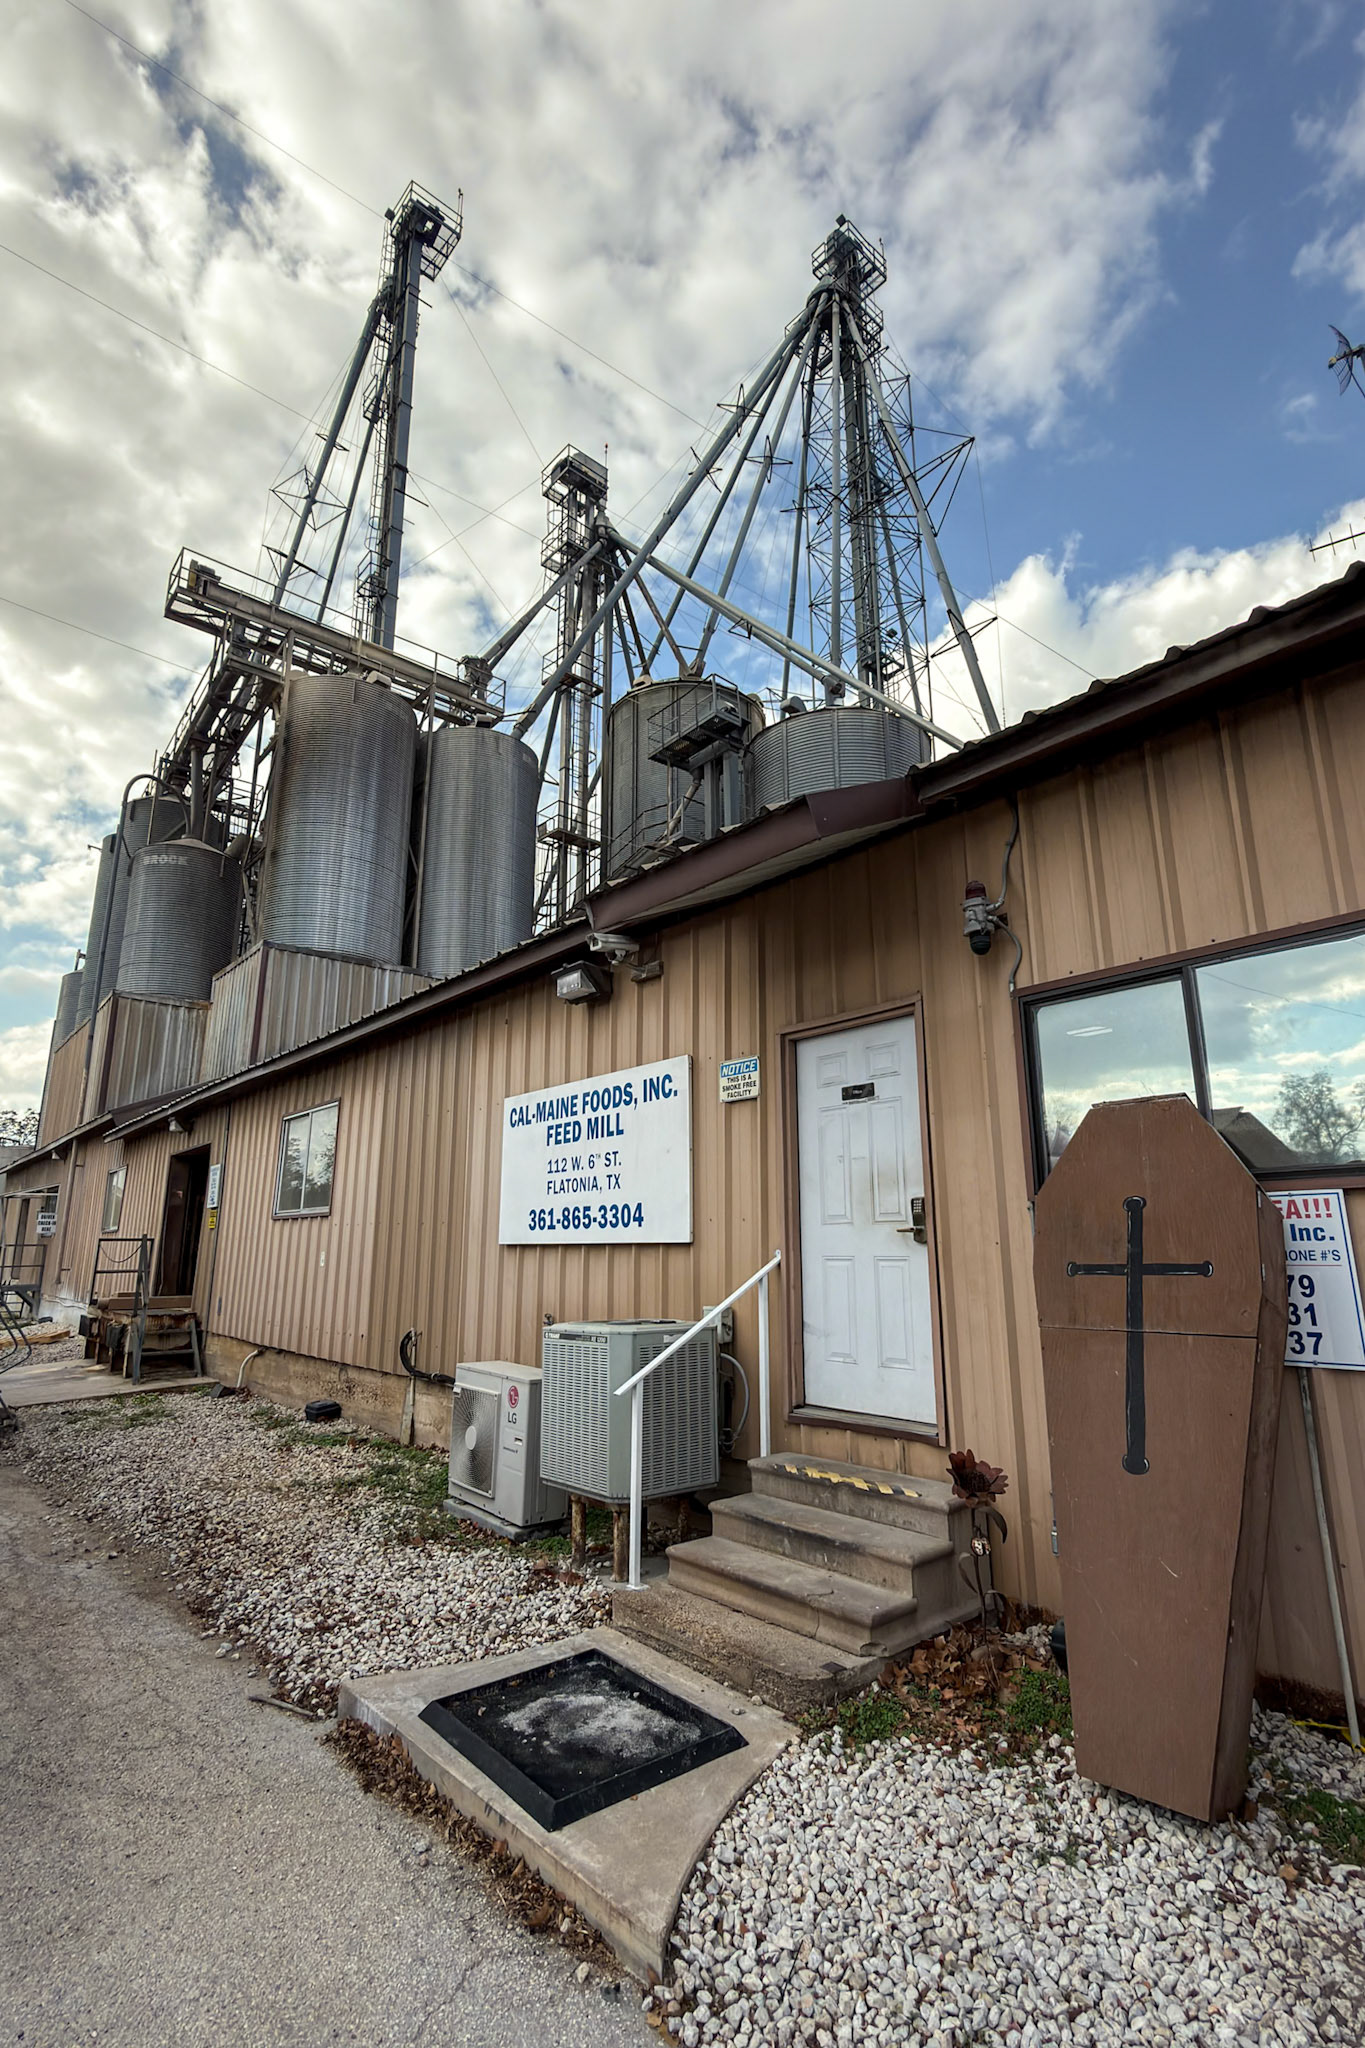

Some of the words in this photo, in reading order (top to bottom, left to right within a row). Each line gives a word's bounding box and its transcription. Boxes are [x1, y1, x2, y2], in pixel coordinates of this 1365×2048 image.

[721, 1060, 756, 1077] NOTICE
[722, 1083, 741, 1092] SMOKE
[742, 1080, 757, 1089] FREE
[727, 1076, 739, 1084] THIS
[741, 1074, 747, 1082] IS
[509, 1094, 578, 1128] CAL-MAINE
[582, 1082, 638, 1114] FOODS,
[643, 1073, 678, 1103] INC.
[727, 1089, 752, 1098] FACILITY
[546, 1120, 582, 1146] FEED
[587, 1112, 624, 1141] MILL
[547, 1157, 568, 1174] 112
[571, 1155, 584, 1171] W.
[604, 1150, 622, 1168] ST.
[547, 1175, 602, 1195] FLATONIA,
[606, 1173, 621, 1190] TX
[528, 1202, 644, 1231] 361-865-3304
[1289, 1223, 1335, 1241] Inc.
[1285, 1249, 1317, 1261] ONE
[1288, 1302, 1318, 1327] 31
[1288, 1330, 1323, 1356] 37
[507, 1411, 517, 1425] LG
